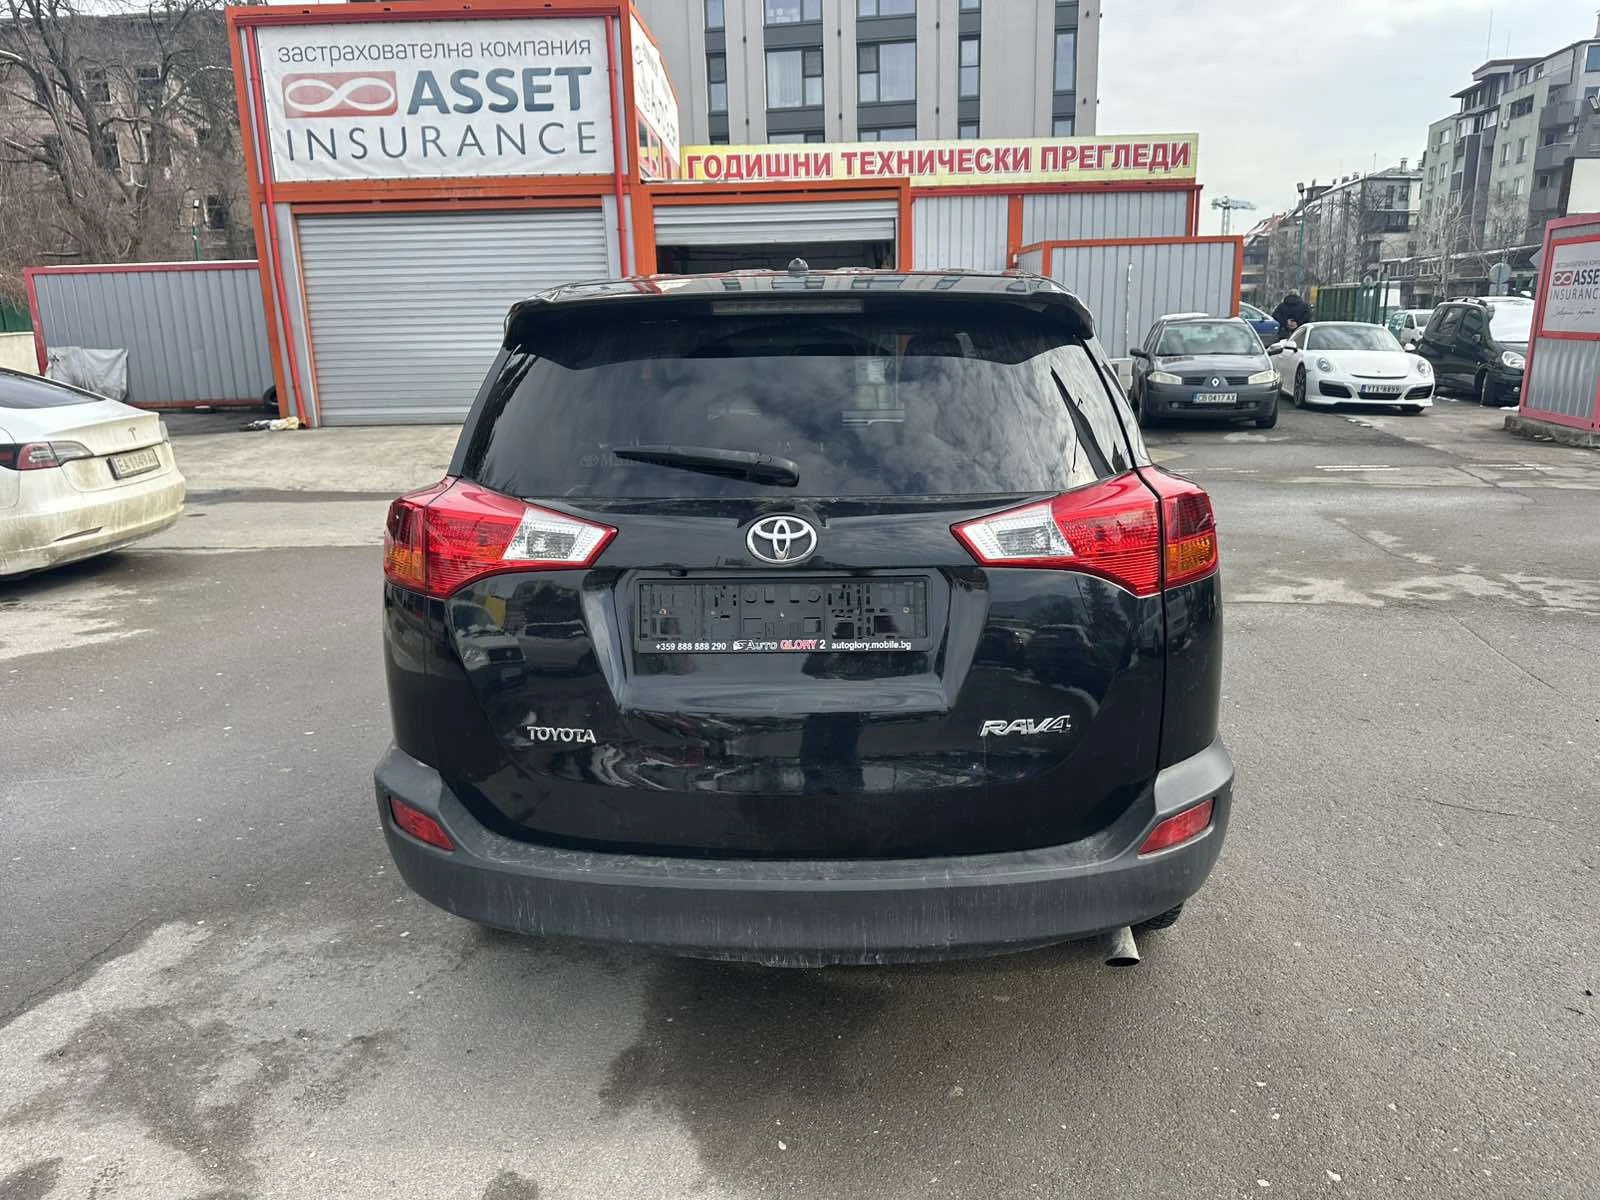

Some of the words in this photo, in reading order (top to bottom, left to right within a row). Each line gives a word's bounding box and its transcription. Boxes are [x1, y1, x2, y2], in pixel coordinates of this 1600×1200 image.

[278, 41, 473, 67] застрахователна
[480, 39, 591, 57] компания
[407, 66, 592, 115] ASSET
[286, 121, 597, 161] INSURANCE
[687, 152, 831, 181] ГОДИШНИ
[841, 148, 1032, 175] ТЕХНИЧЕСКИ
[1040, 143, 1190, 173] ПРЕГЛЕДИ
[1550, 287, 1600, 301] INSURANC
[655, 642, 676, 651] +359
[677, 642, 692, 651] 888
[694, 642, 709, 651] 888
[711, 642, 727, 651] 290
[779, 639, 818, 650] GLORY
[819, 639, 826, 650] 2
[831, 640, 912, 651] autoglory.mobile.bg
[526, 726, 597, 744] TOYOTA
[979, 715, 1072, 737] RAV4
